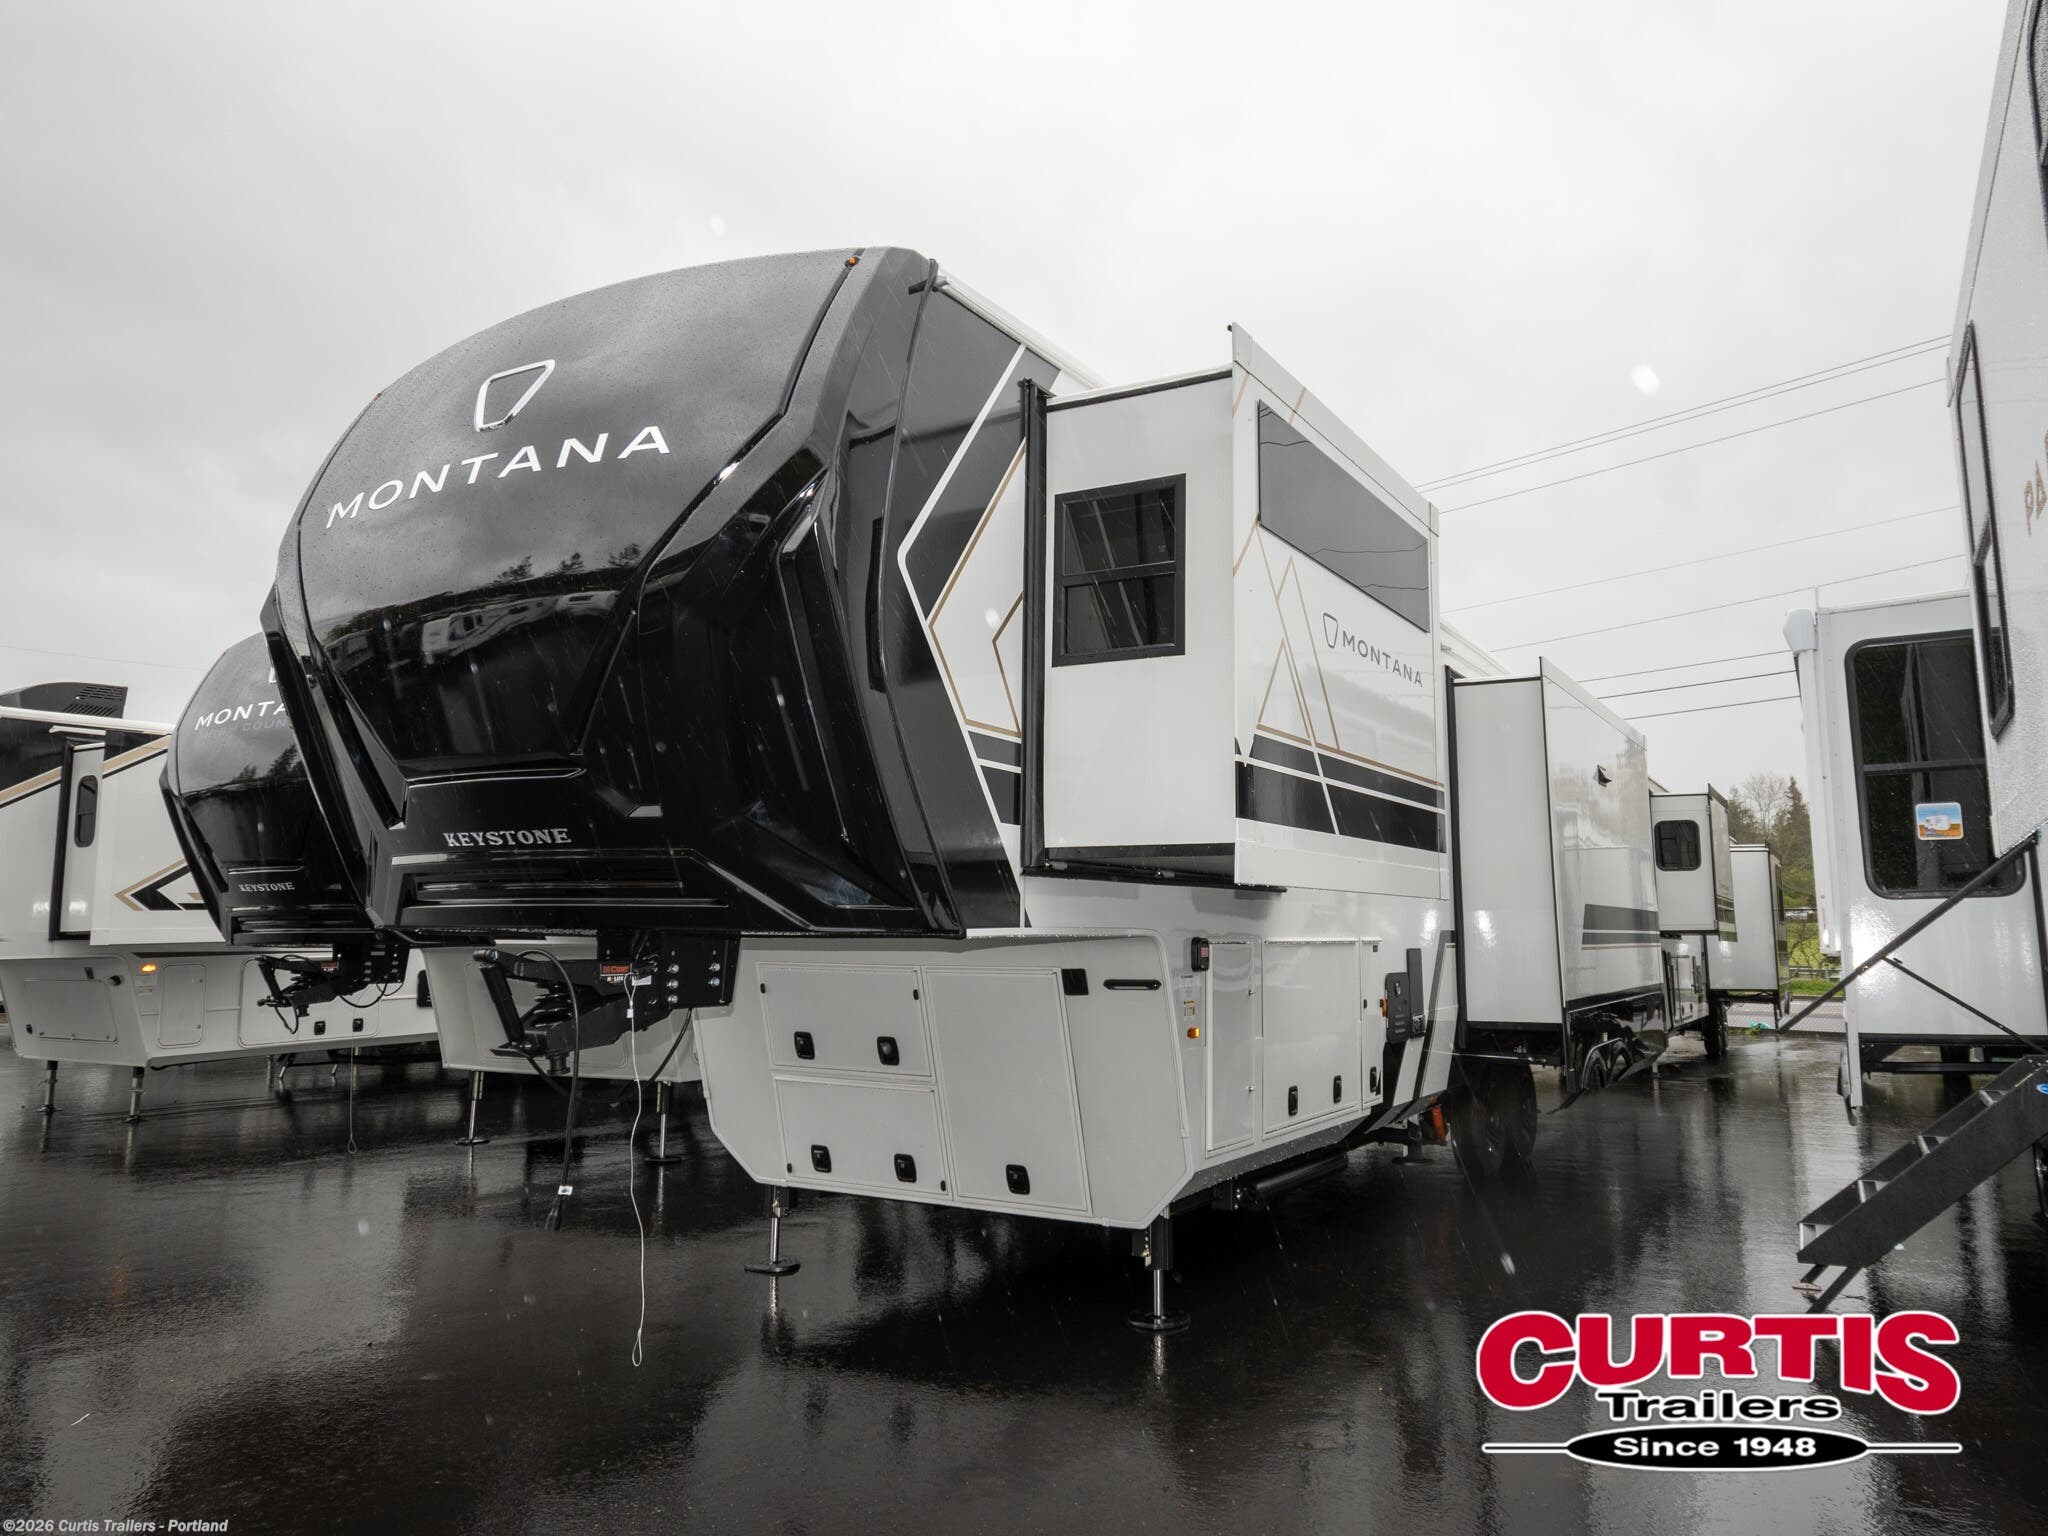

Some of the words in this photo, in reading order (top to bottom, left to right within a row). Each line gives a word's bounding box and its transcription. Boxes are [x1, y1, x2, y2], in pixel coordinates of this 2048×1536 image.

[325, 424, 671, 530] MONTANA
[1342, 629, 1423, 688] MONTANA
[442, 828, 573, 847] KEYSTONE
[238, 881, 296, 892] KEYSTONE
